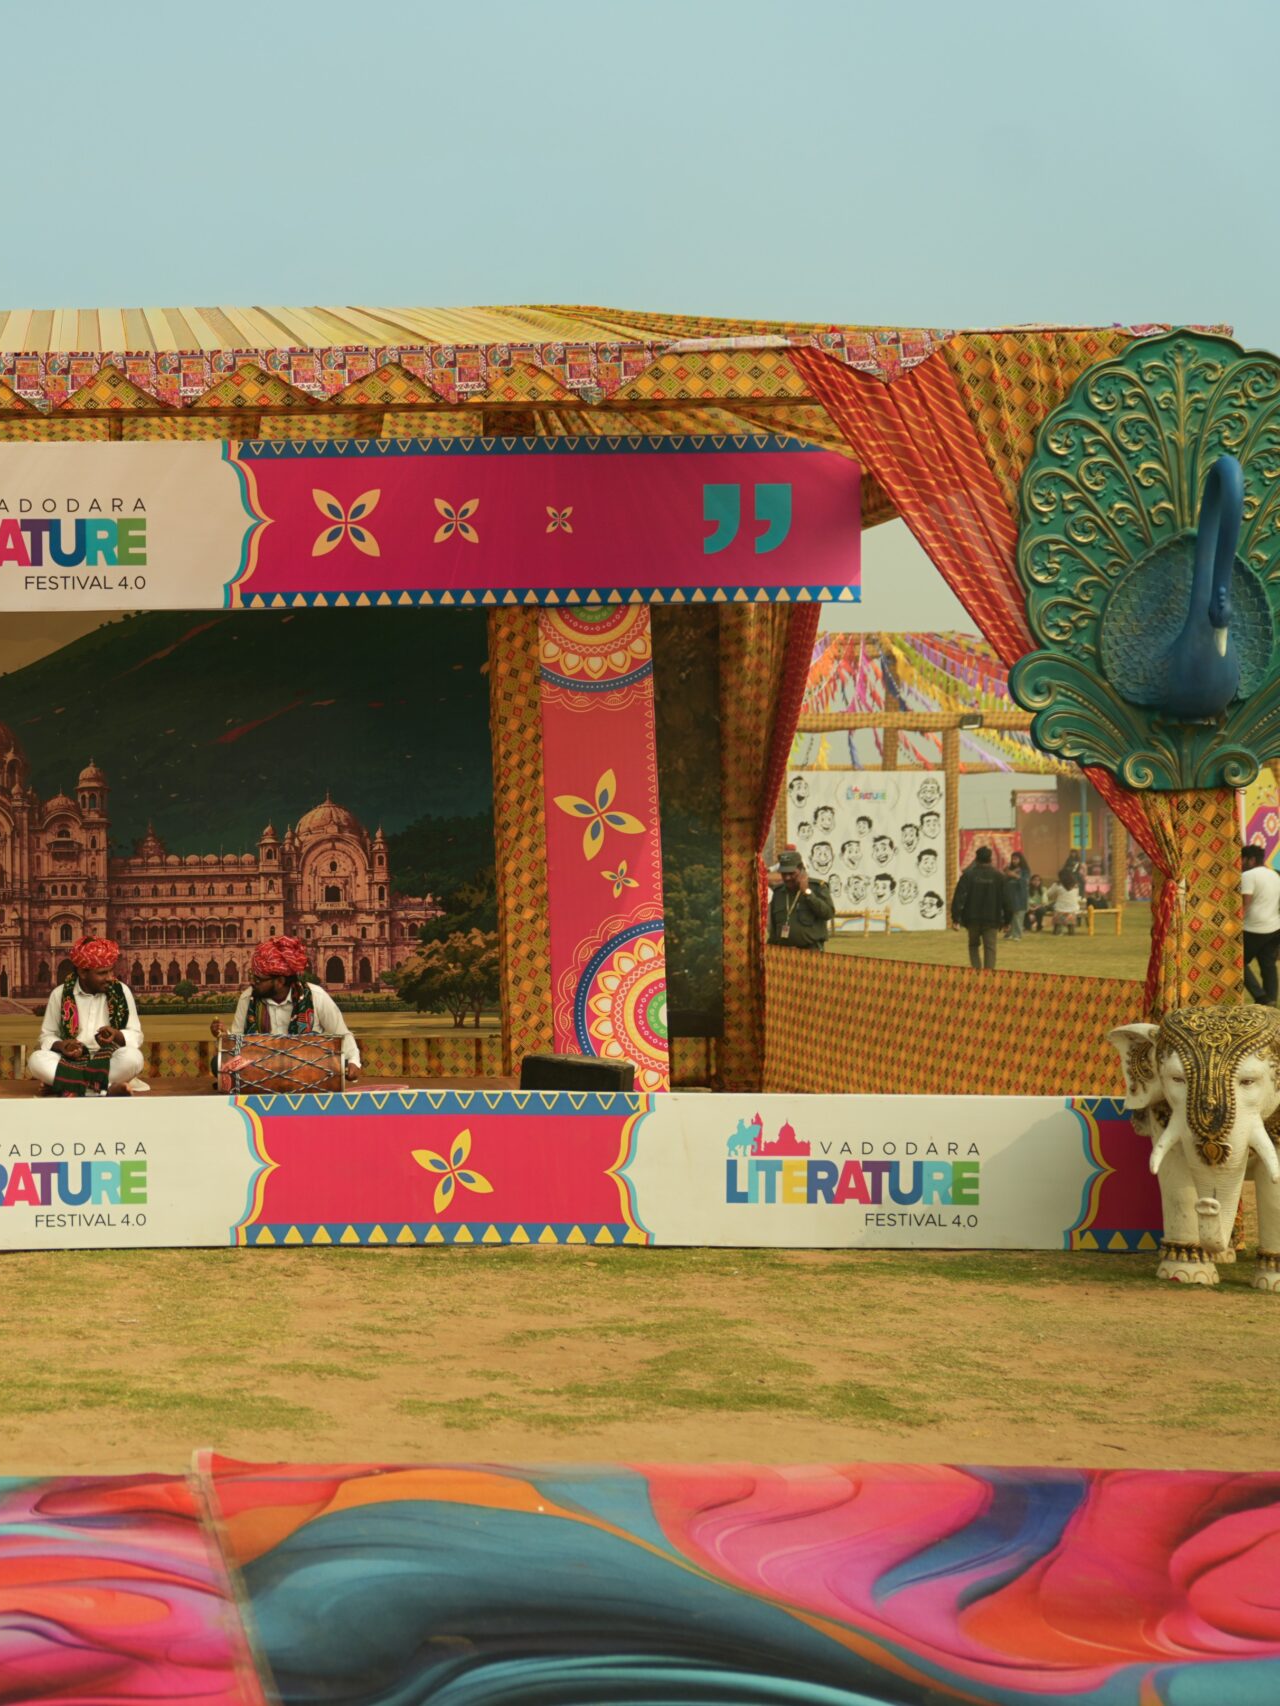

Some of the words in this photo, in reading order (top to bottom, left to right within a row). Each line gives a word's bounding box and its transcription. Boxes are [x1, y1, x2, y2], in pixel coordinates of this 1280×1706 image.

[24, 576, 113, 590] FESTIVAL
[117, 575, 146, 590] 4.0
[820, 1142, 980, 1156] VADODARA
[726, 1159, 980, 1206] LITERATURE
[34, 1214, 116, 1228] FESTIVAL
[120, 1213, 147, 1227] 4.0
[865, 1212, 947, 1227] FESTIVAL
[951, 1214, 978, 1228] 4.0
